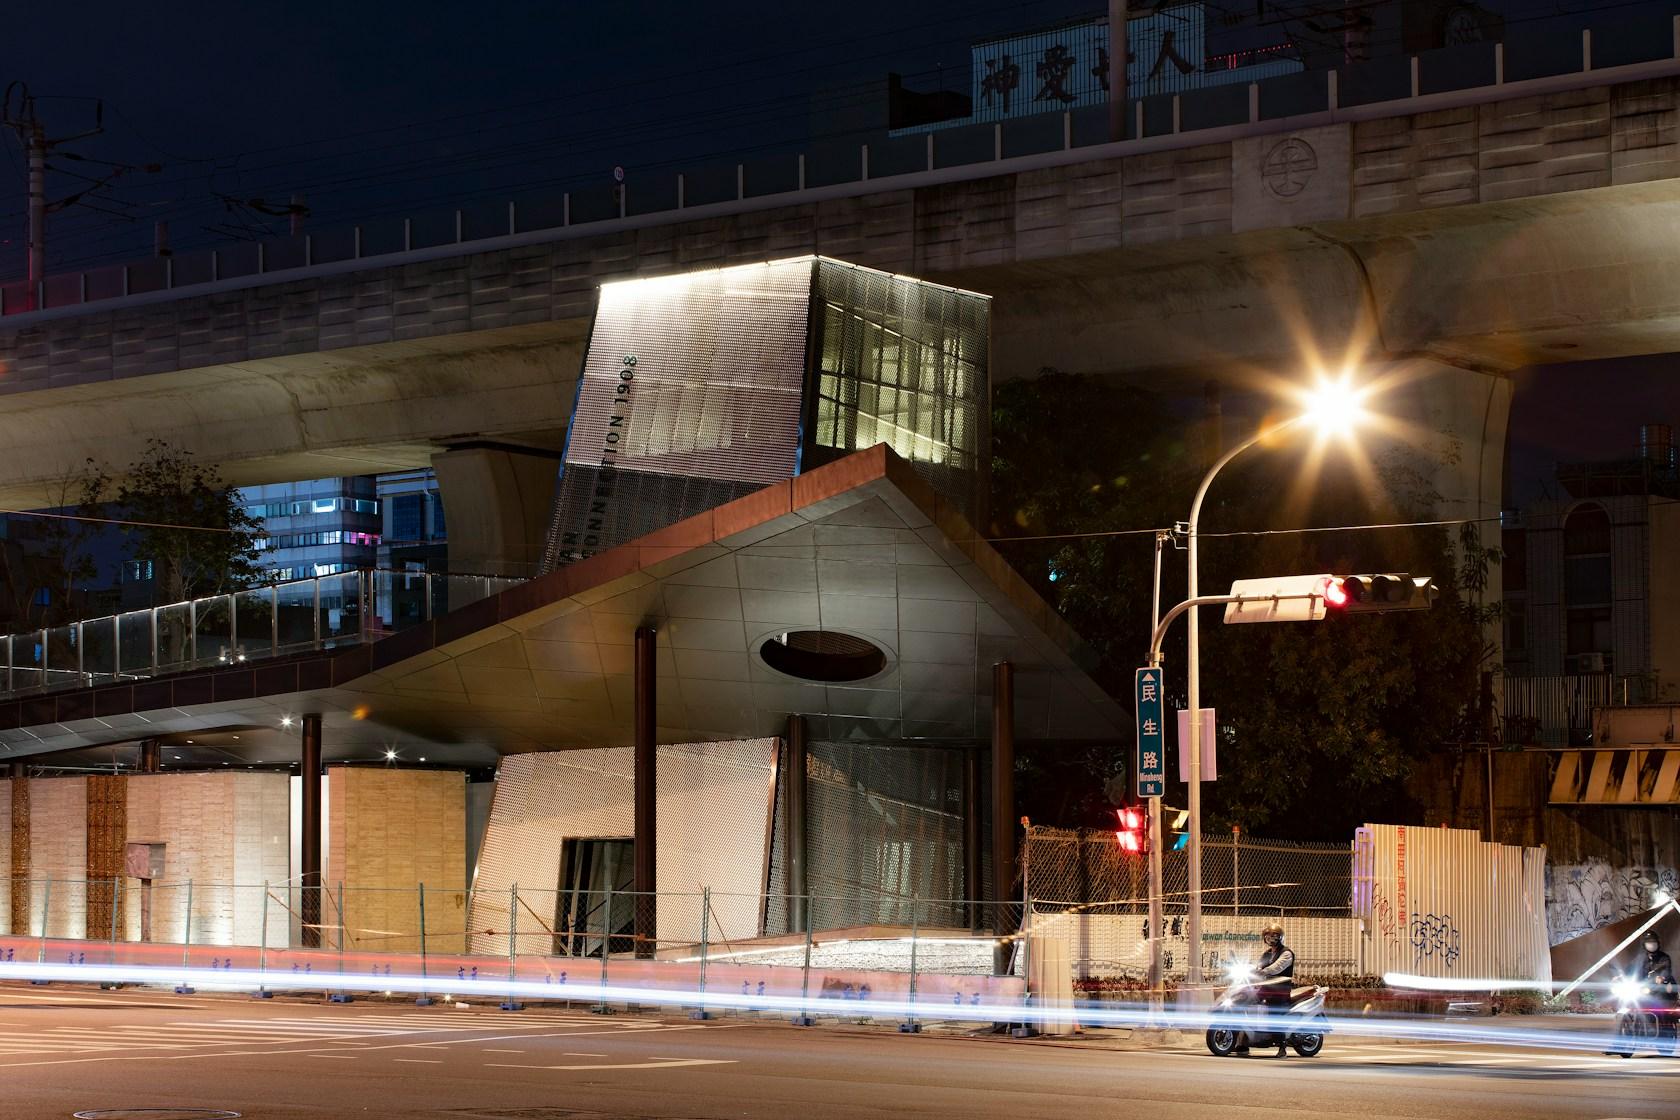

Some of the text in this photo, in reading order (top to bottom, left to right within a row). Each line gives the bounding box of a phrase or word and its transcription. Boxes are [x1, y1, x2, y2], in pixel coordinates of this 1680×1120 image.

[614, 355, 638, 405] 1908
[1141, 685, 1159, 769] 民生路
